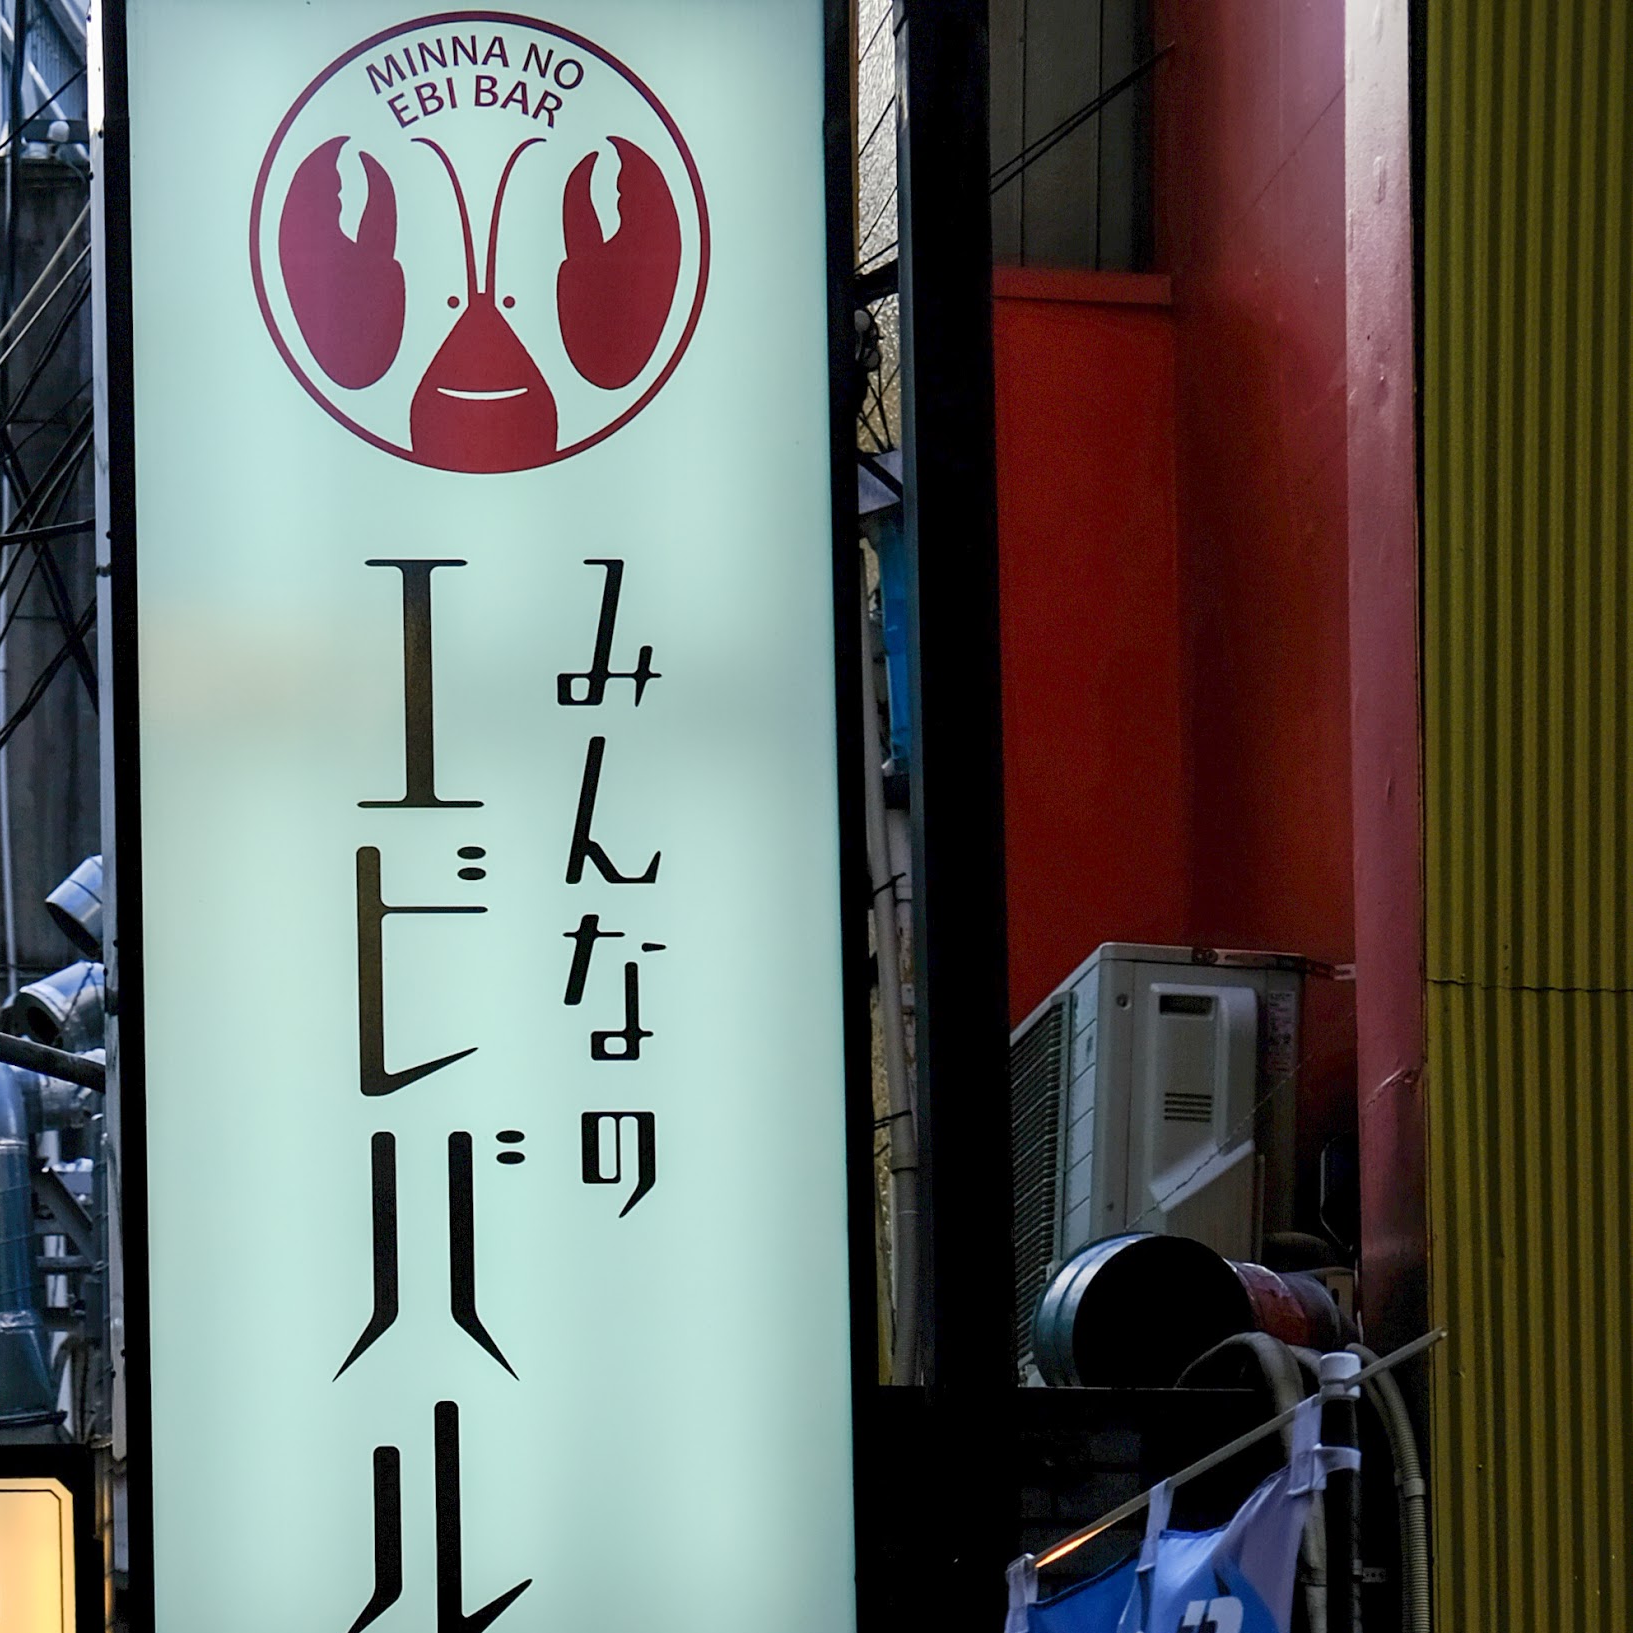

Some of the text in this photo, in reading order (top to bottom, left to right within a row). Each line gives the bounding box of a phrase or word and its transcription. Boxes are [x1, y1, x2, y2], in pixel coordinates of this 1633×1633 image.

[366, 34, 586, 95] MINNA NO
[386, 74, 564, 130] EBI BAR
[556, 558, 665, 1219] みんなの
